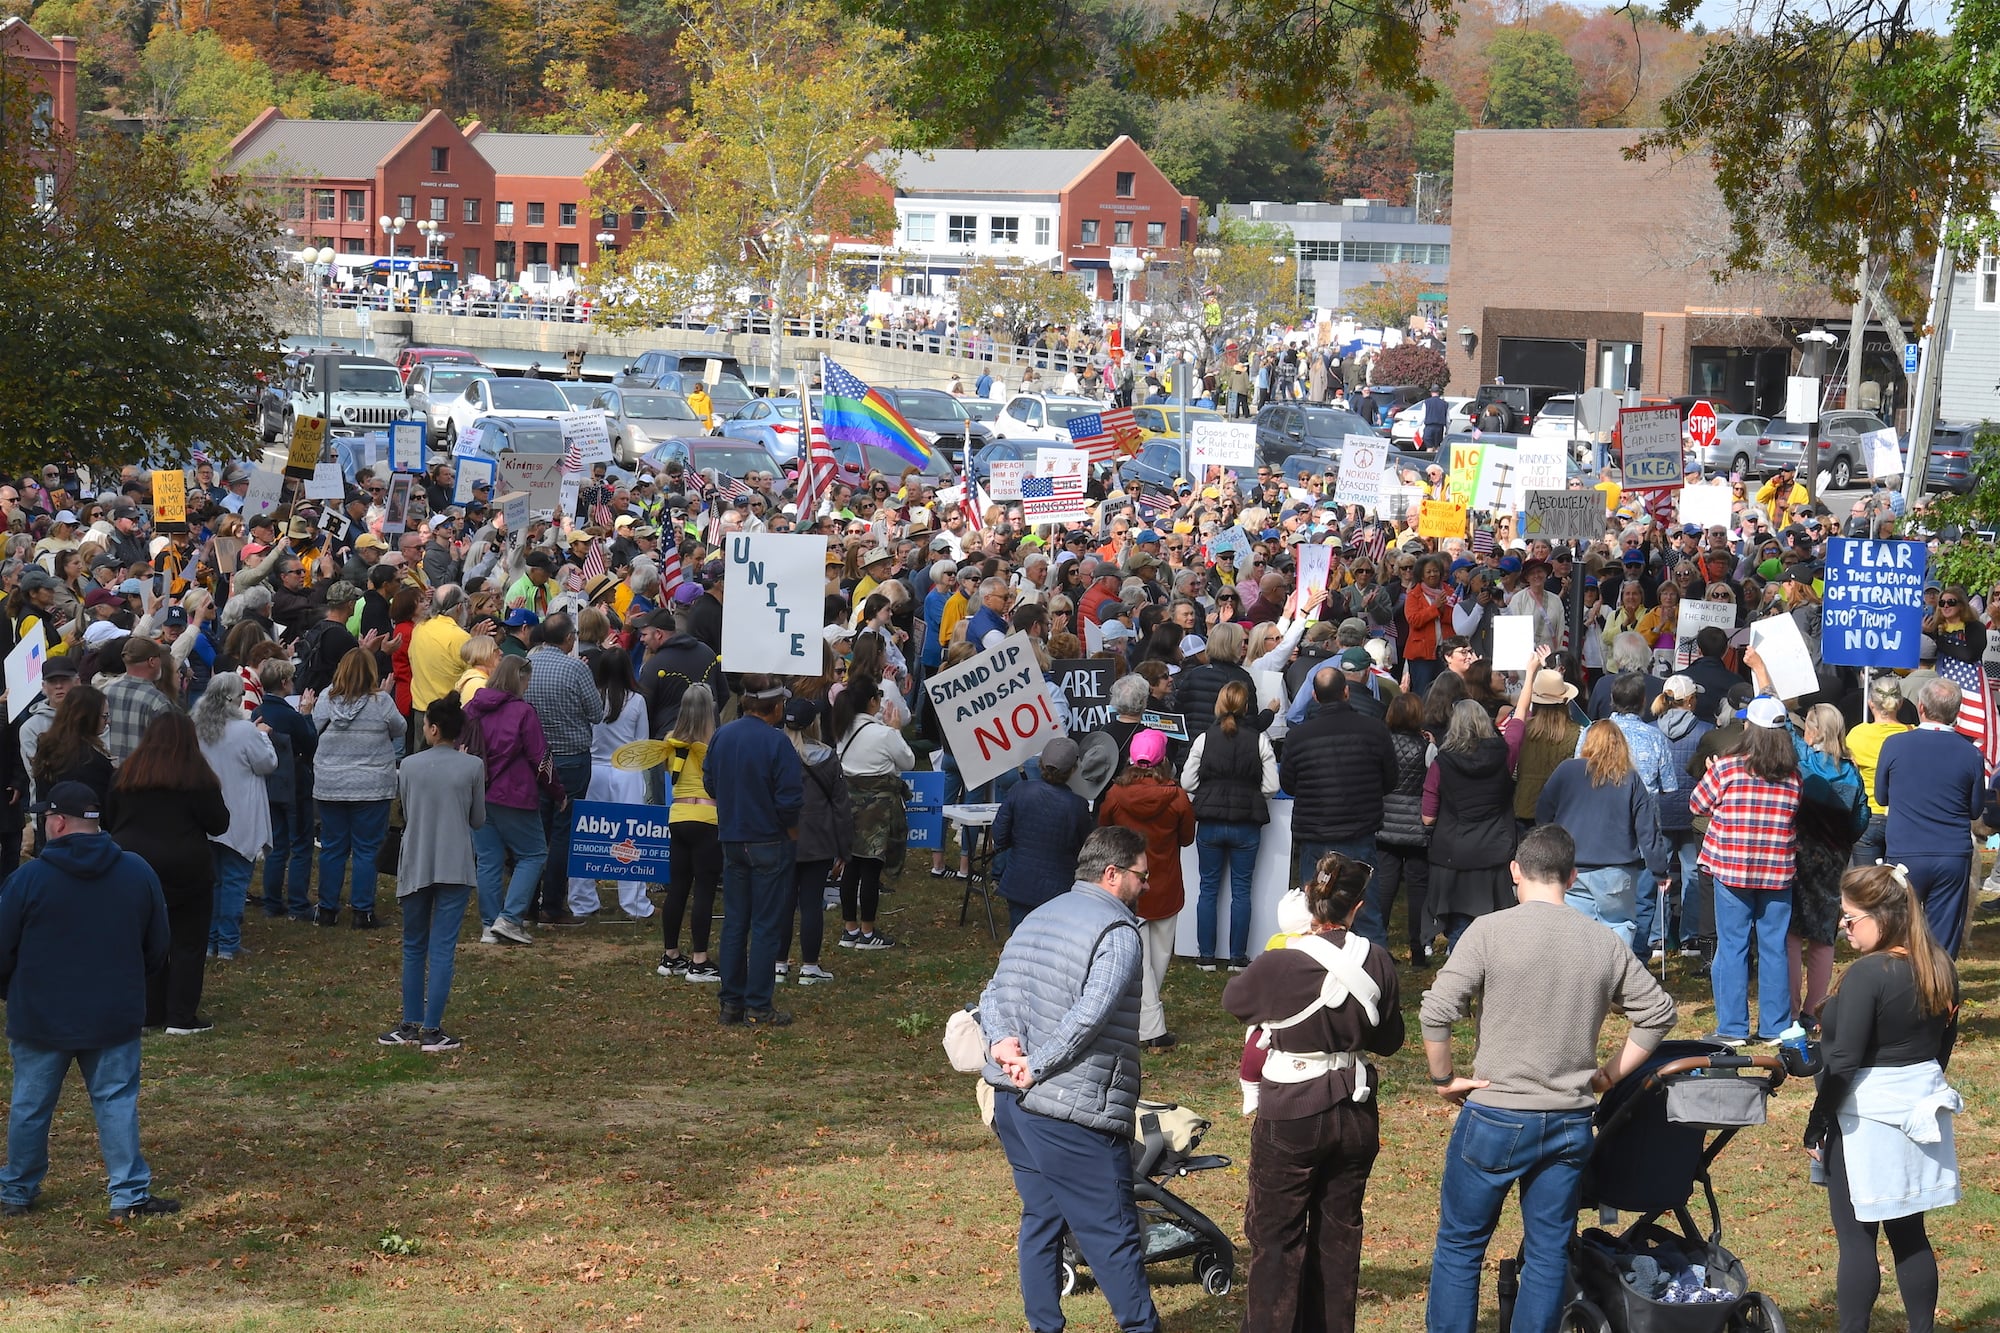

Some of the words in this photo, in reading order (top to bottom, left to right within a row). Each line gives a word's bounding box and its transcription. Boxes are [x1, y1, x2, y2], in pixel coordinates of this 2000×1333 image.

[1626, 411, 1648, 424] HAVE
[1654, 409, 1678, 420] SEEN
[304, 418, 308, 428] I
[1628, 422, 1658, 433] BETTER
[1690, 416, 1714, 434] STOP
[1196, 426, 1228, 437] Choose
[1230, 428, 1250, 438] One
[1208, 437, 1227, 448] Rule
[1227, 440, 1236, 448] of
[1238, 440, 1254, 450] Law
[1624, 433, 1676, 448] CABINETS
[301, 444, 312, 452] NO
[1208, 448, 1240, 459] Rulers
[292, 452, 316, 463] KINGS
[1519, 454, 1562, 465] KINDNESS
[1531, 466, 1550, 476] NOT
[1632, 460, 1676, 476] IKEA
[162, 473, 174, 482] NO
[1346, 468, 1357, 478] NO
[1358, 470, 1380, 481] KINGS
[1346, 480, 1378, 492] FASCISTS
[1521, 476, 1562, 488] CRUELTY
[158, 483, 181, 494] KINGS
[249, 489, 259, 498] NO
[262, 492, 280, 500] KINGS
[168, 495, 178, 504] MY
[1336, 492, 1346, 500] NO
[1346, 492, 1378, 504] TYRANTS
[1427, 502, 1454, 511] AMERICA
[1422, 520, 1434, 530] NO
[1544, 509, 1565, 536] NO
[1568, 509, 1605, 538] KINGS
[1843, 540, 1912, 569] FEAR
[1827, 568, 1838, 581] IS
[1846, 569, 1872, 583] THE
[1876, 570, 1921, 585] WEAPON
[734, 536, 806, 657] UNITE
[1828, 586, 1846, 600] OF
[1847, 585, 1922, 608] TYRANTS
[1690, 602, 1711, 610] HONK
[1712, 604, 1728, 612] FOR
[1685, 613, 1699, 621] THE
[1700, 614, 1719, 623] RULE
[1825, 608, 1857, 627] STOP
[1859, 610, 1896, 629] TRUMP
[1844, 629, 1902, 650] NOW
[931, 665, 990, 704] STAND
[991, 646, 1020, 673] UP
[1060, 669, 1107, 698] ARE
[956, 692, 998, 722] AND
[998, 668, 1030, 700] SAY
[974, 694, 1060, 761] NO!
[575, 816, 621, 839] Abby
[585, 862, 600, 872] For
[603, 864, 628, 875] Every
[631, 865, 655, 875] Child
